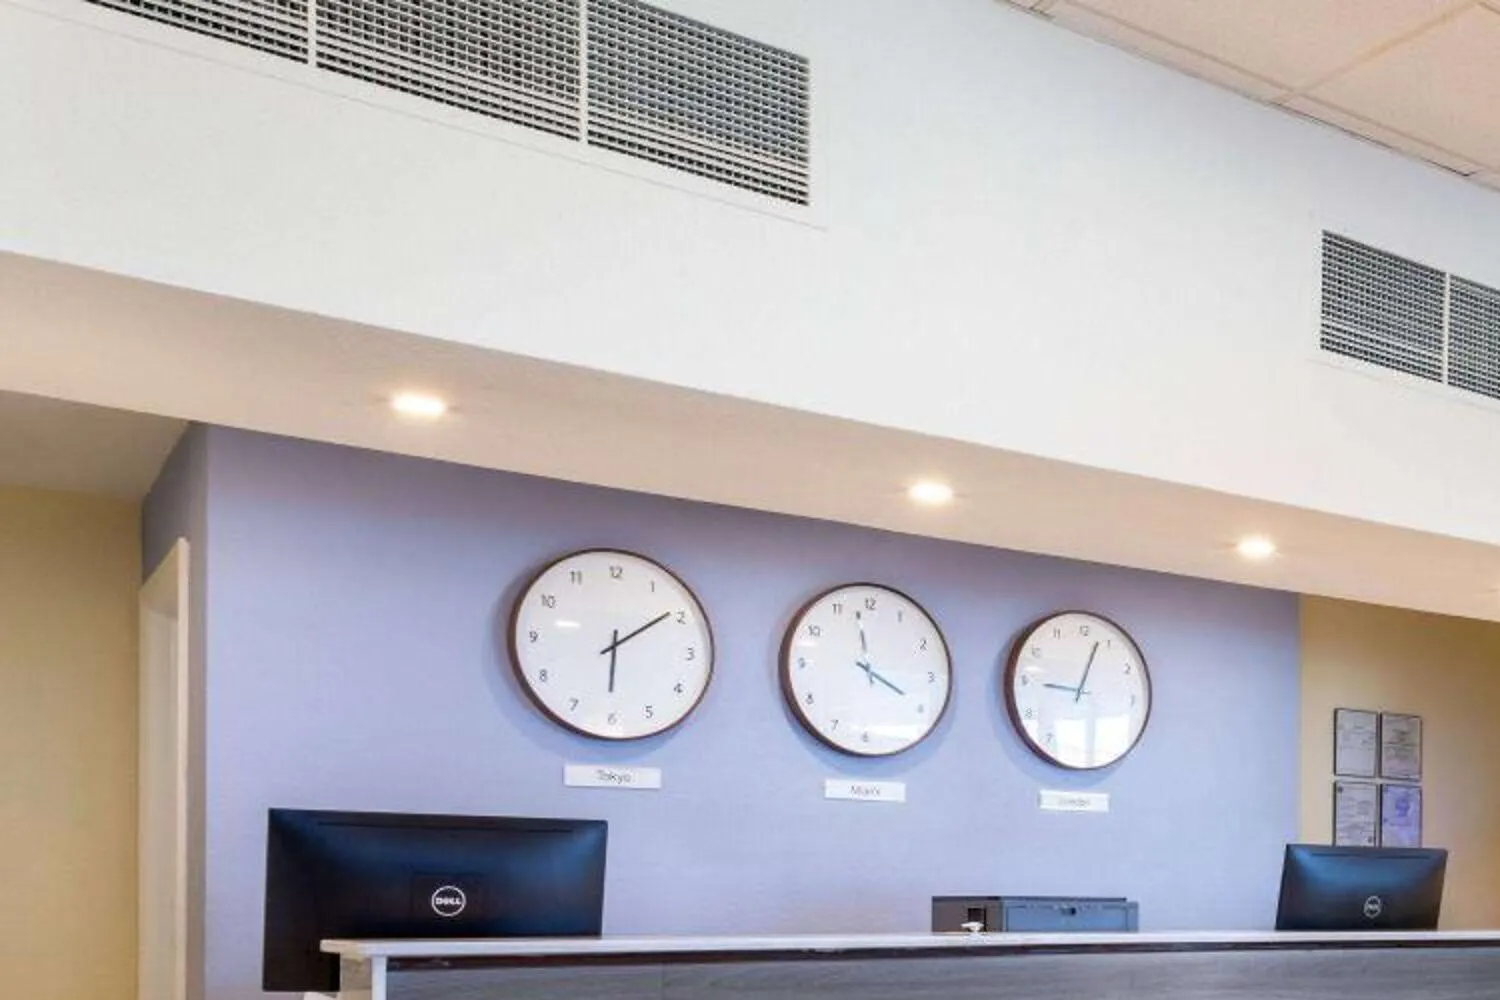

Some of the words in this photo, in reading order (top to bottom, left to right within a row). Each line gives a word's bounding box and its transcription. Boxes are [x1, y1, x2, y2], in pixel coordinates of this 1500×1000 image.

[569, 570, 583, 585] 11
[609, 565, 624, 580] 12
[541, 593, 556, 609] 10
[864, 598, 877, 611] 12
[831, 602, 844, 615] 11
[676, 611, 686, 625] 2
[529, 630, 539, 644] 9
[808, 625, 821, 638] 10
[1078, 624, 1090, 637] 12
[919, 638, 928, 651] 2
[685, 648, 696, 661] 3
[538, 669, 549, 683] 8
[927, 671, 936, 684] 3
[673, 683, 684, 695] 4
[569, 698, 580, 712] 7
[644, 706, 654, 719] 5
[607, 713, 618, 726] 6
[830, 719, 839, 731] 7
[435, 897, 462, 905] DELL
